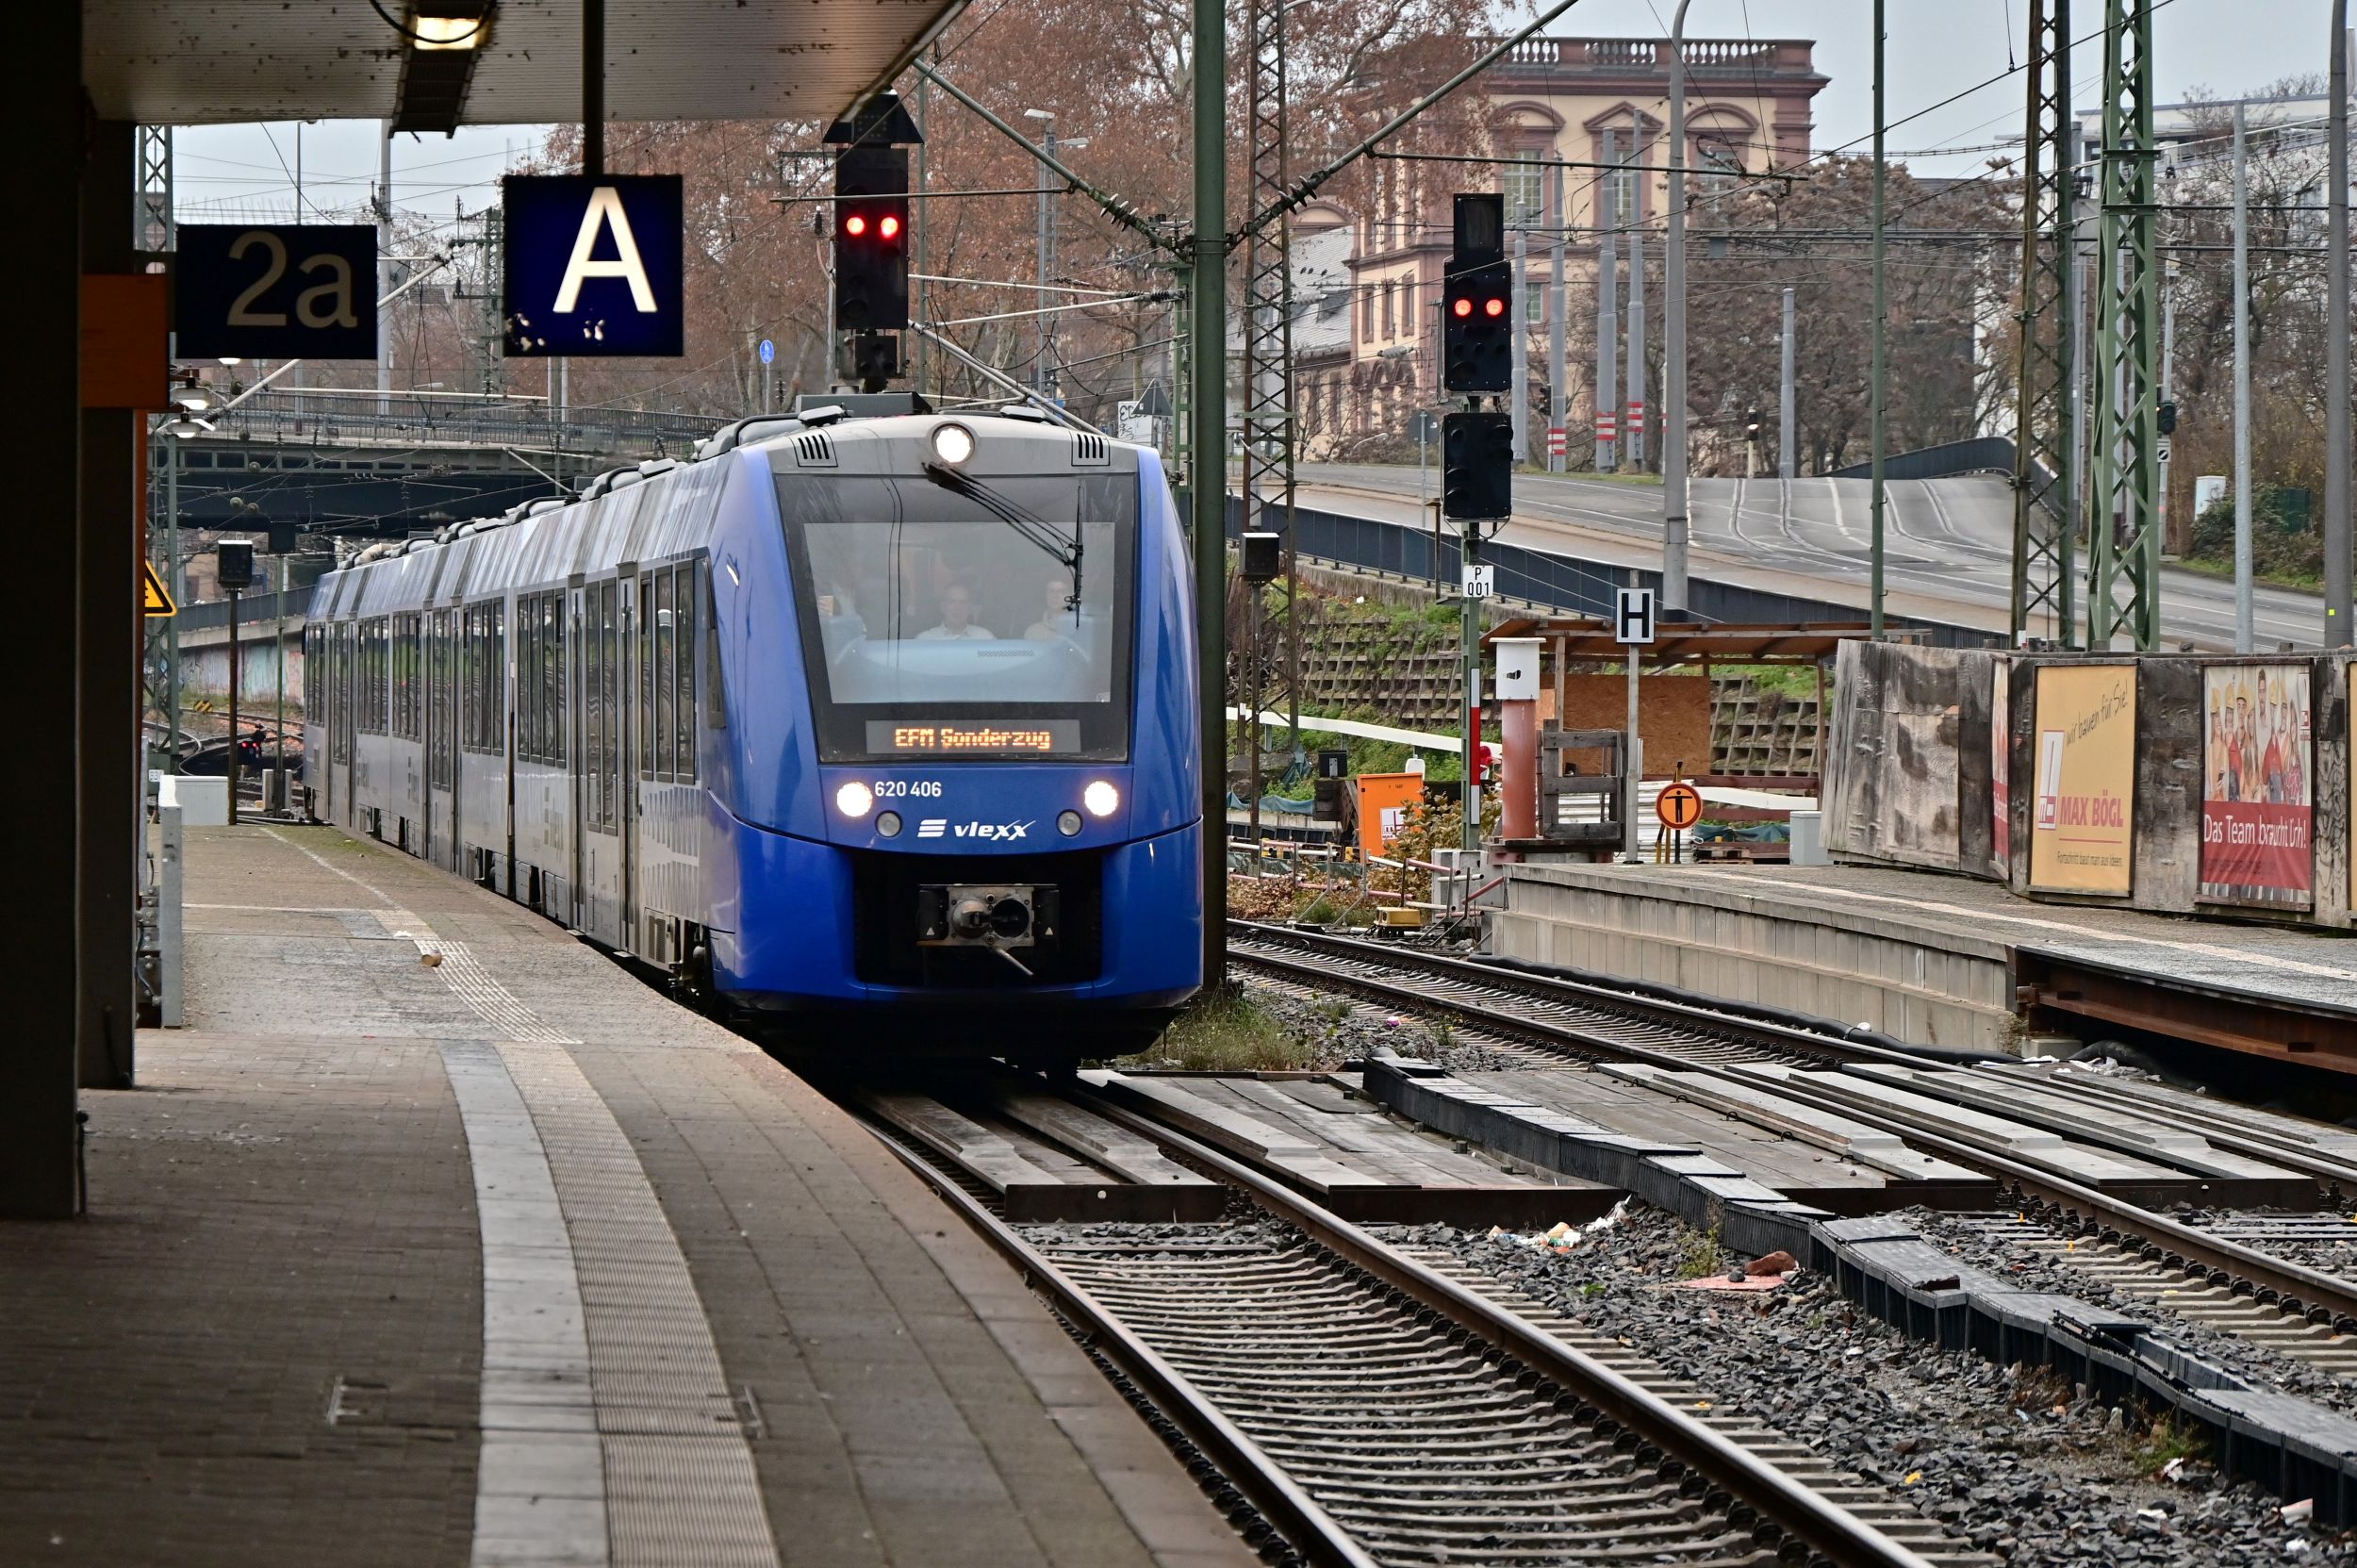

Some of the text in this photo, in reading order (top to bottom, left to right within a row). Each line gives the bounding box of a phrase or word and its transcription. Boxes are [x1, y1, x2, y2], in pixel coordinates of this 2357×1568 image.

[552, 187, 658, 313] A
[226, 230, 358, 328] 2a
[1475, 567, 1482, 581] P
[1621, 592, 1650, 638] H
[2067, 679, 2129, 748] wir bauen für Sie!
[896, 728, 1051, 750] EFM Sonderzug
[874, 781, 942, 798] 620 406
[2059, 789, 2124, 828] MAX BÖGL
[953, 819, 1037, 841] vlexx
[2203, 814, 2223, 844] Das
[2225, 815, 2255, 845] Team
[2258, 814, 2288, 848] braucht
